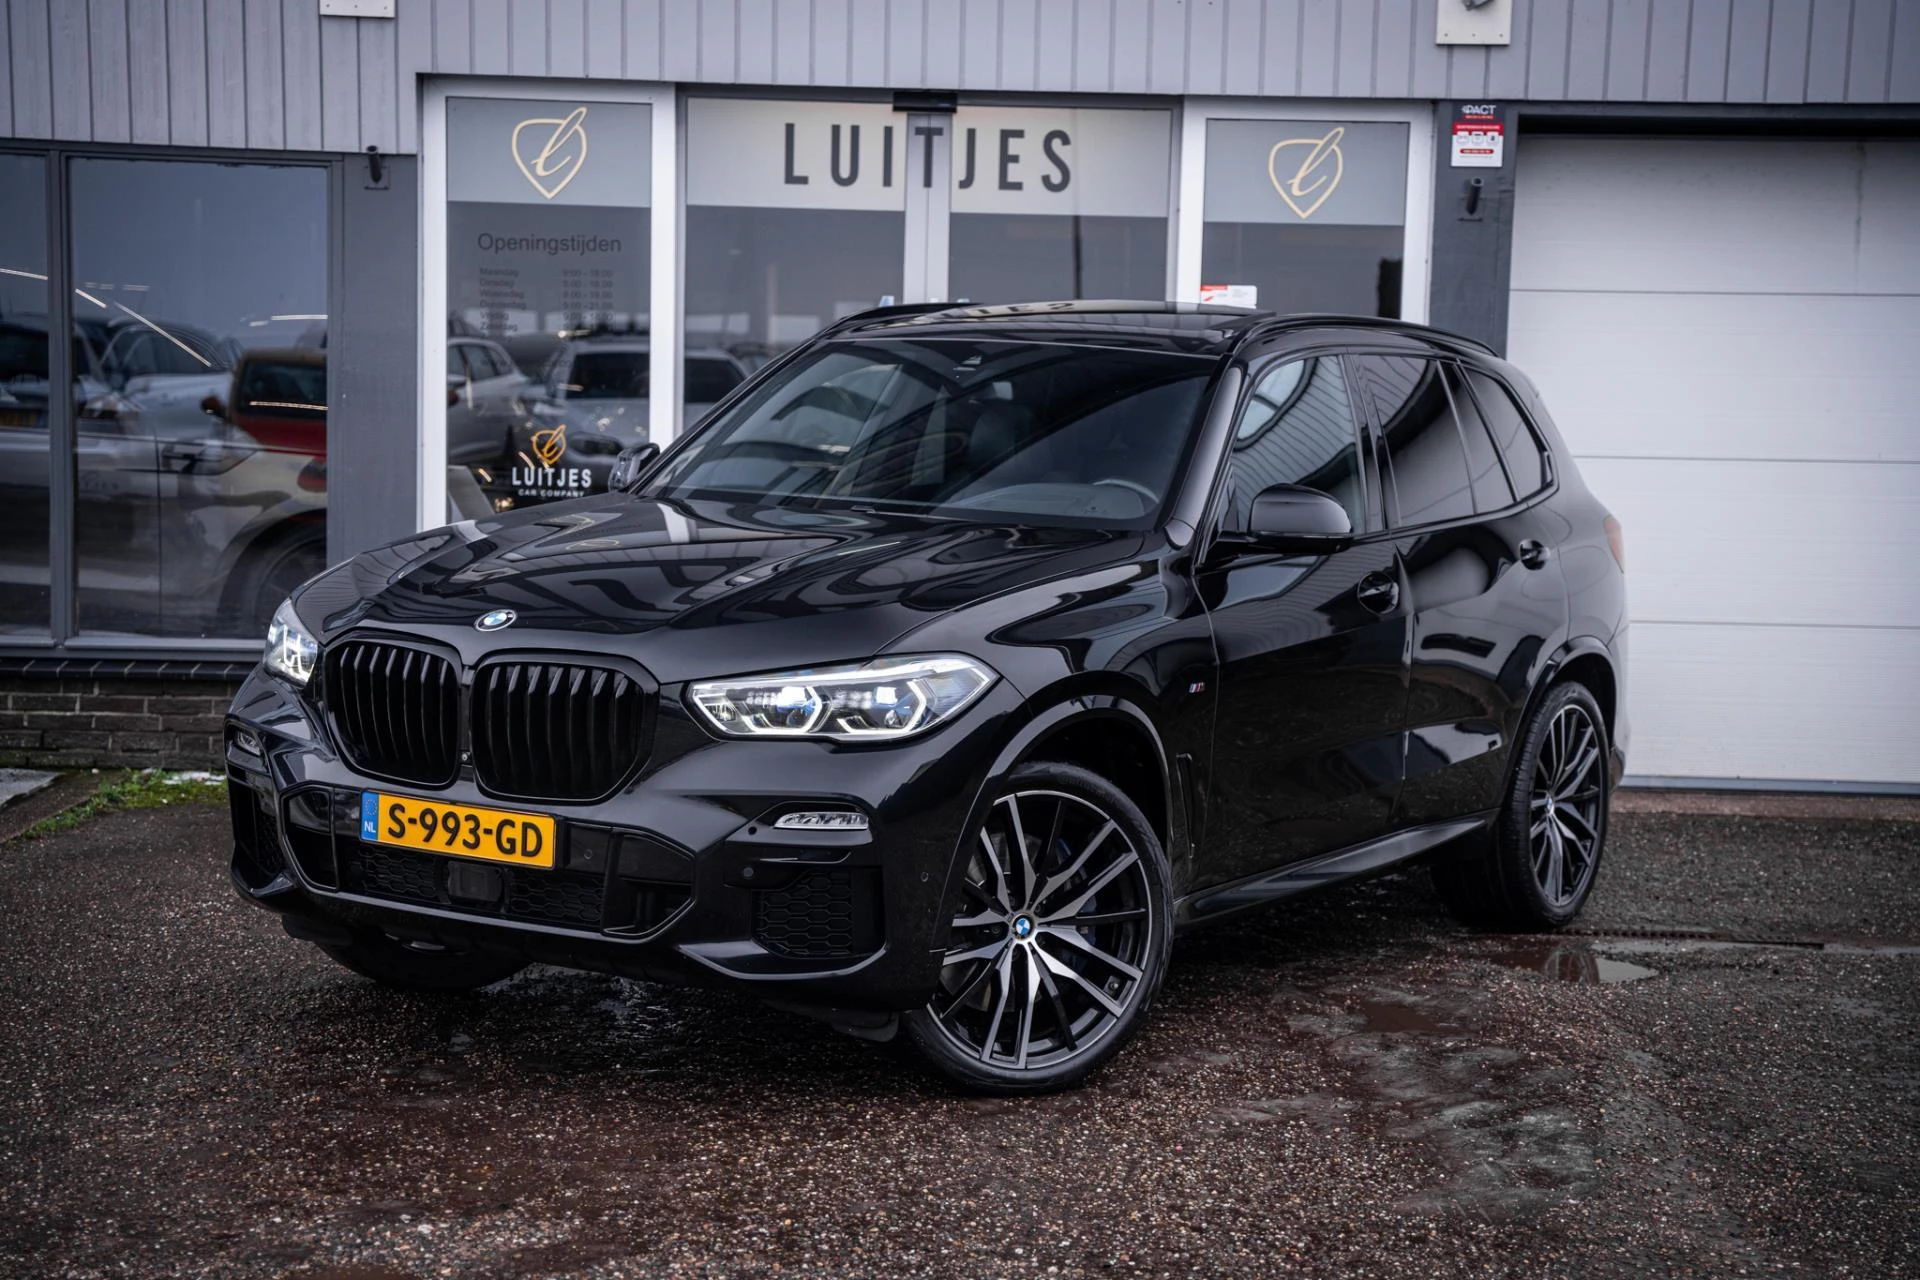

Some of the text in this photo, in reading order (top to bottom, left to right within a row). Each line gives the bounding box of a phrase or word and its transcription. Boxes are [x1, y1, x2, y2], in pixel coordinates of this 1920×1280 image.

[784, 122, 1072, 193] LUITJES
[477, 232, 622, 256] Openingstijden
[512, 466, 592, 488] LUITJES
[518, 489, 585, 498] CAR COMPANY
[364, 820, 377, 834] NL
[387, 803, 543, 858] S-993-GD
